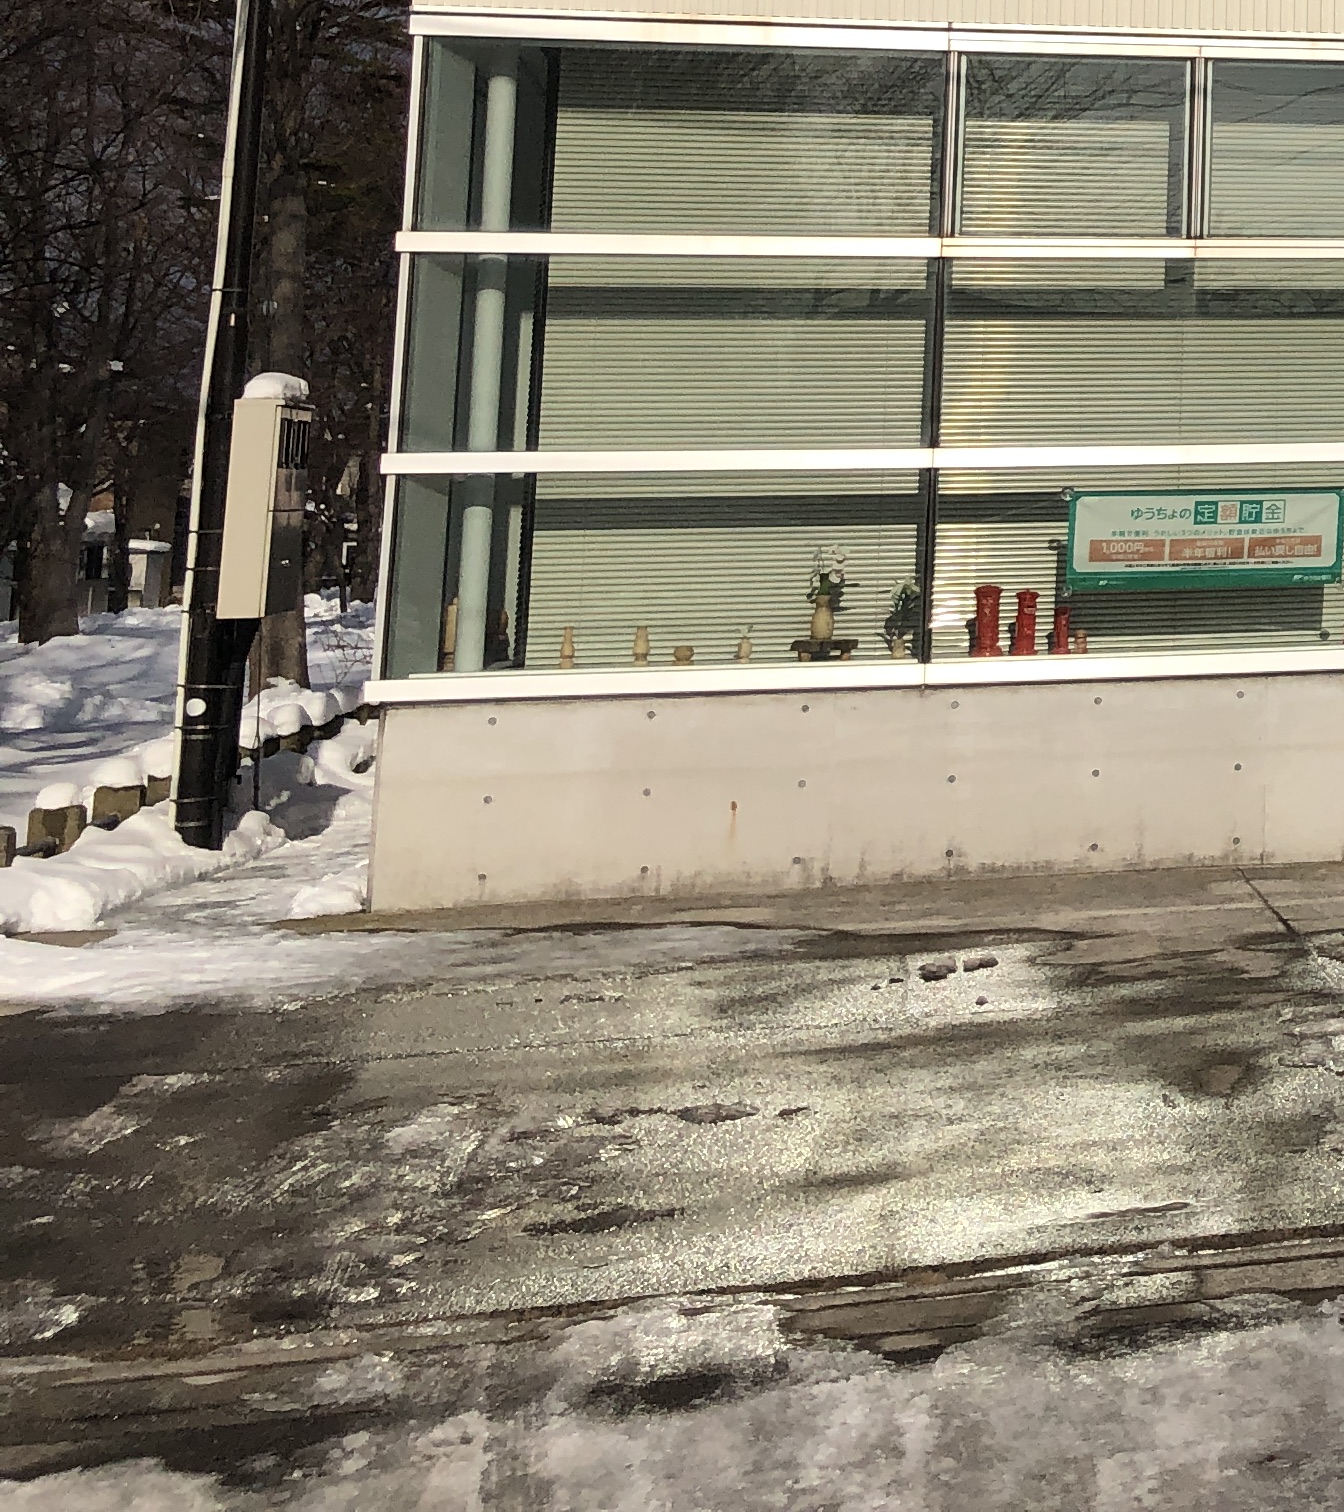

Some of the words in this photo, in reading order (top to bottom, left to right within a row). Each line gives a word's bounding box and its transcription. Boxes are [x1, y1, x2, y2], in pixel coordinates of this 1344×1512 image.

[1130, 500, 1284, 525] ゆうちょの定額貯金
